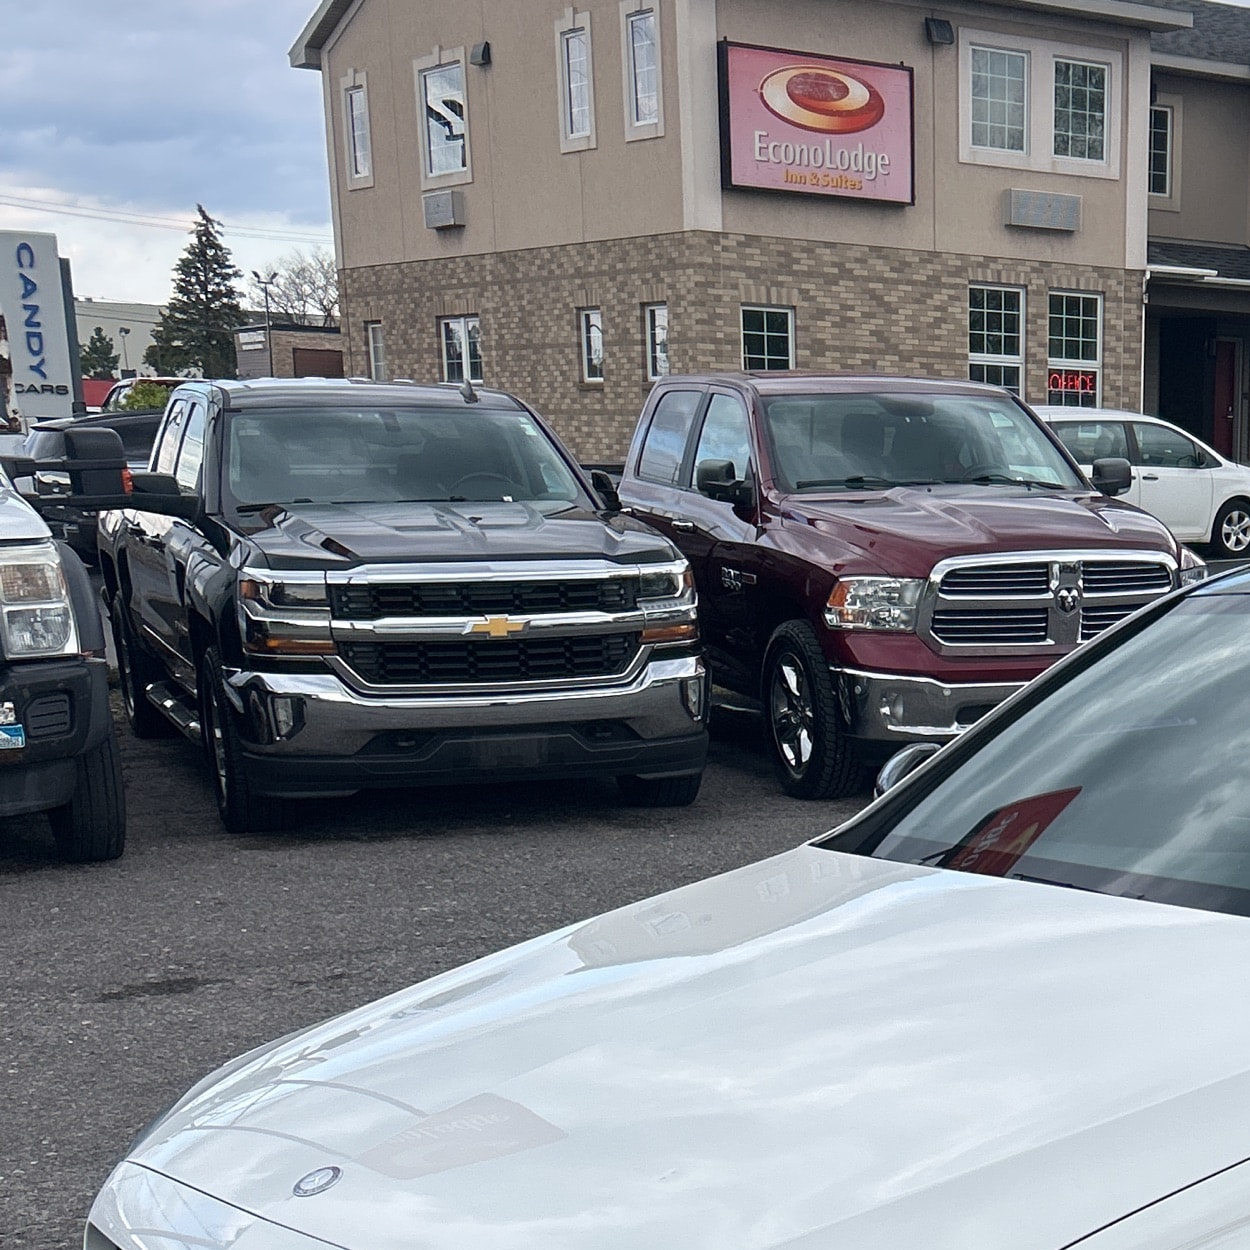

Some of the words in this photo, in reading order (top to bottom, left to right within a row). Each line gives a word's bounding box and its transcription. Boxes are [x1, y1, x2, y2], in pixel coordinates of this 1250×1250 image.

[754, 130, 890, 181] EconoLodge
[784, 169, 806, 184] Inn
[809, 173, 821, 187] &
[821, 174, 863, 191] Suites
[16, 242, 47, 380] CANDY
[14, 383, 69, 396] CARS
